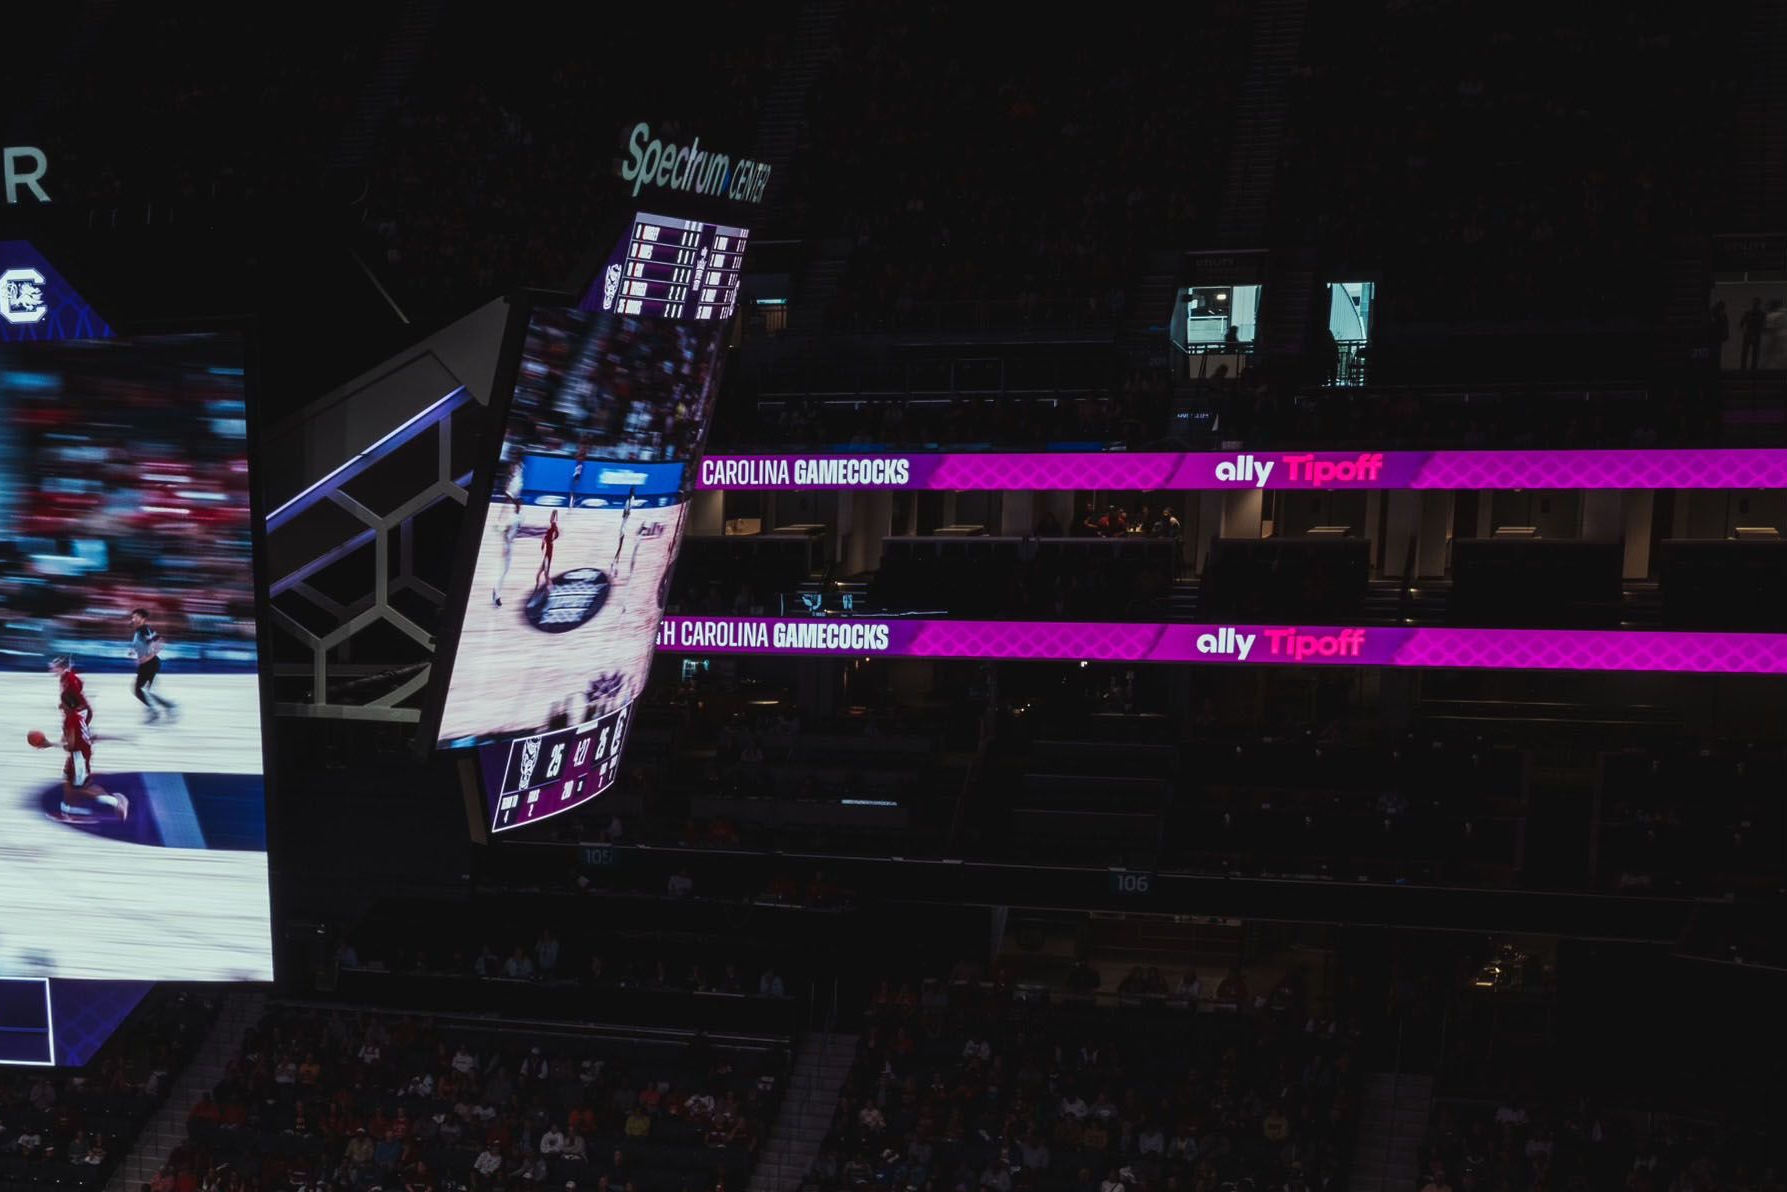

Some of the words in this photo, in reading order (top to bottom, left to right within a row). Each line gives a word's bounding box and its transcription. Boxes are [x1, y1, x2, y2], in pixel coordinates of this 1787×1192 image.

[622, 122, 730, 197] Spectrum
[729, 159, 772, 203] CENTER
[702, 459, 789, 485] CAROLINA
[794, 459, 909, 485] GAMECOCKS
[1215, 455, 1274, 487] ally
[1282, 453, 1383, 487] Tipoff
[681, 621, 768, 648] CAROLINA
[773, 622, 889, 650] GAMECOCKS
[1196, 627, 1256, 660] ally
[1264, 628, 1367, 660] Tipoff
[1118, 875, 1148, 892] 106
